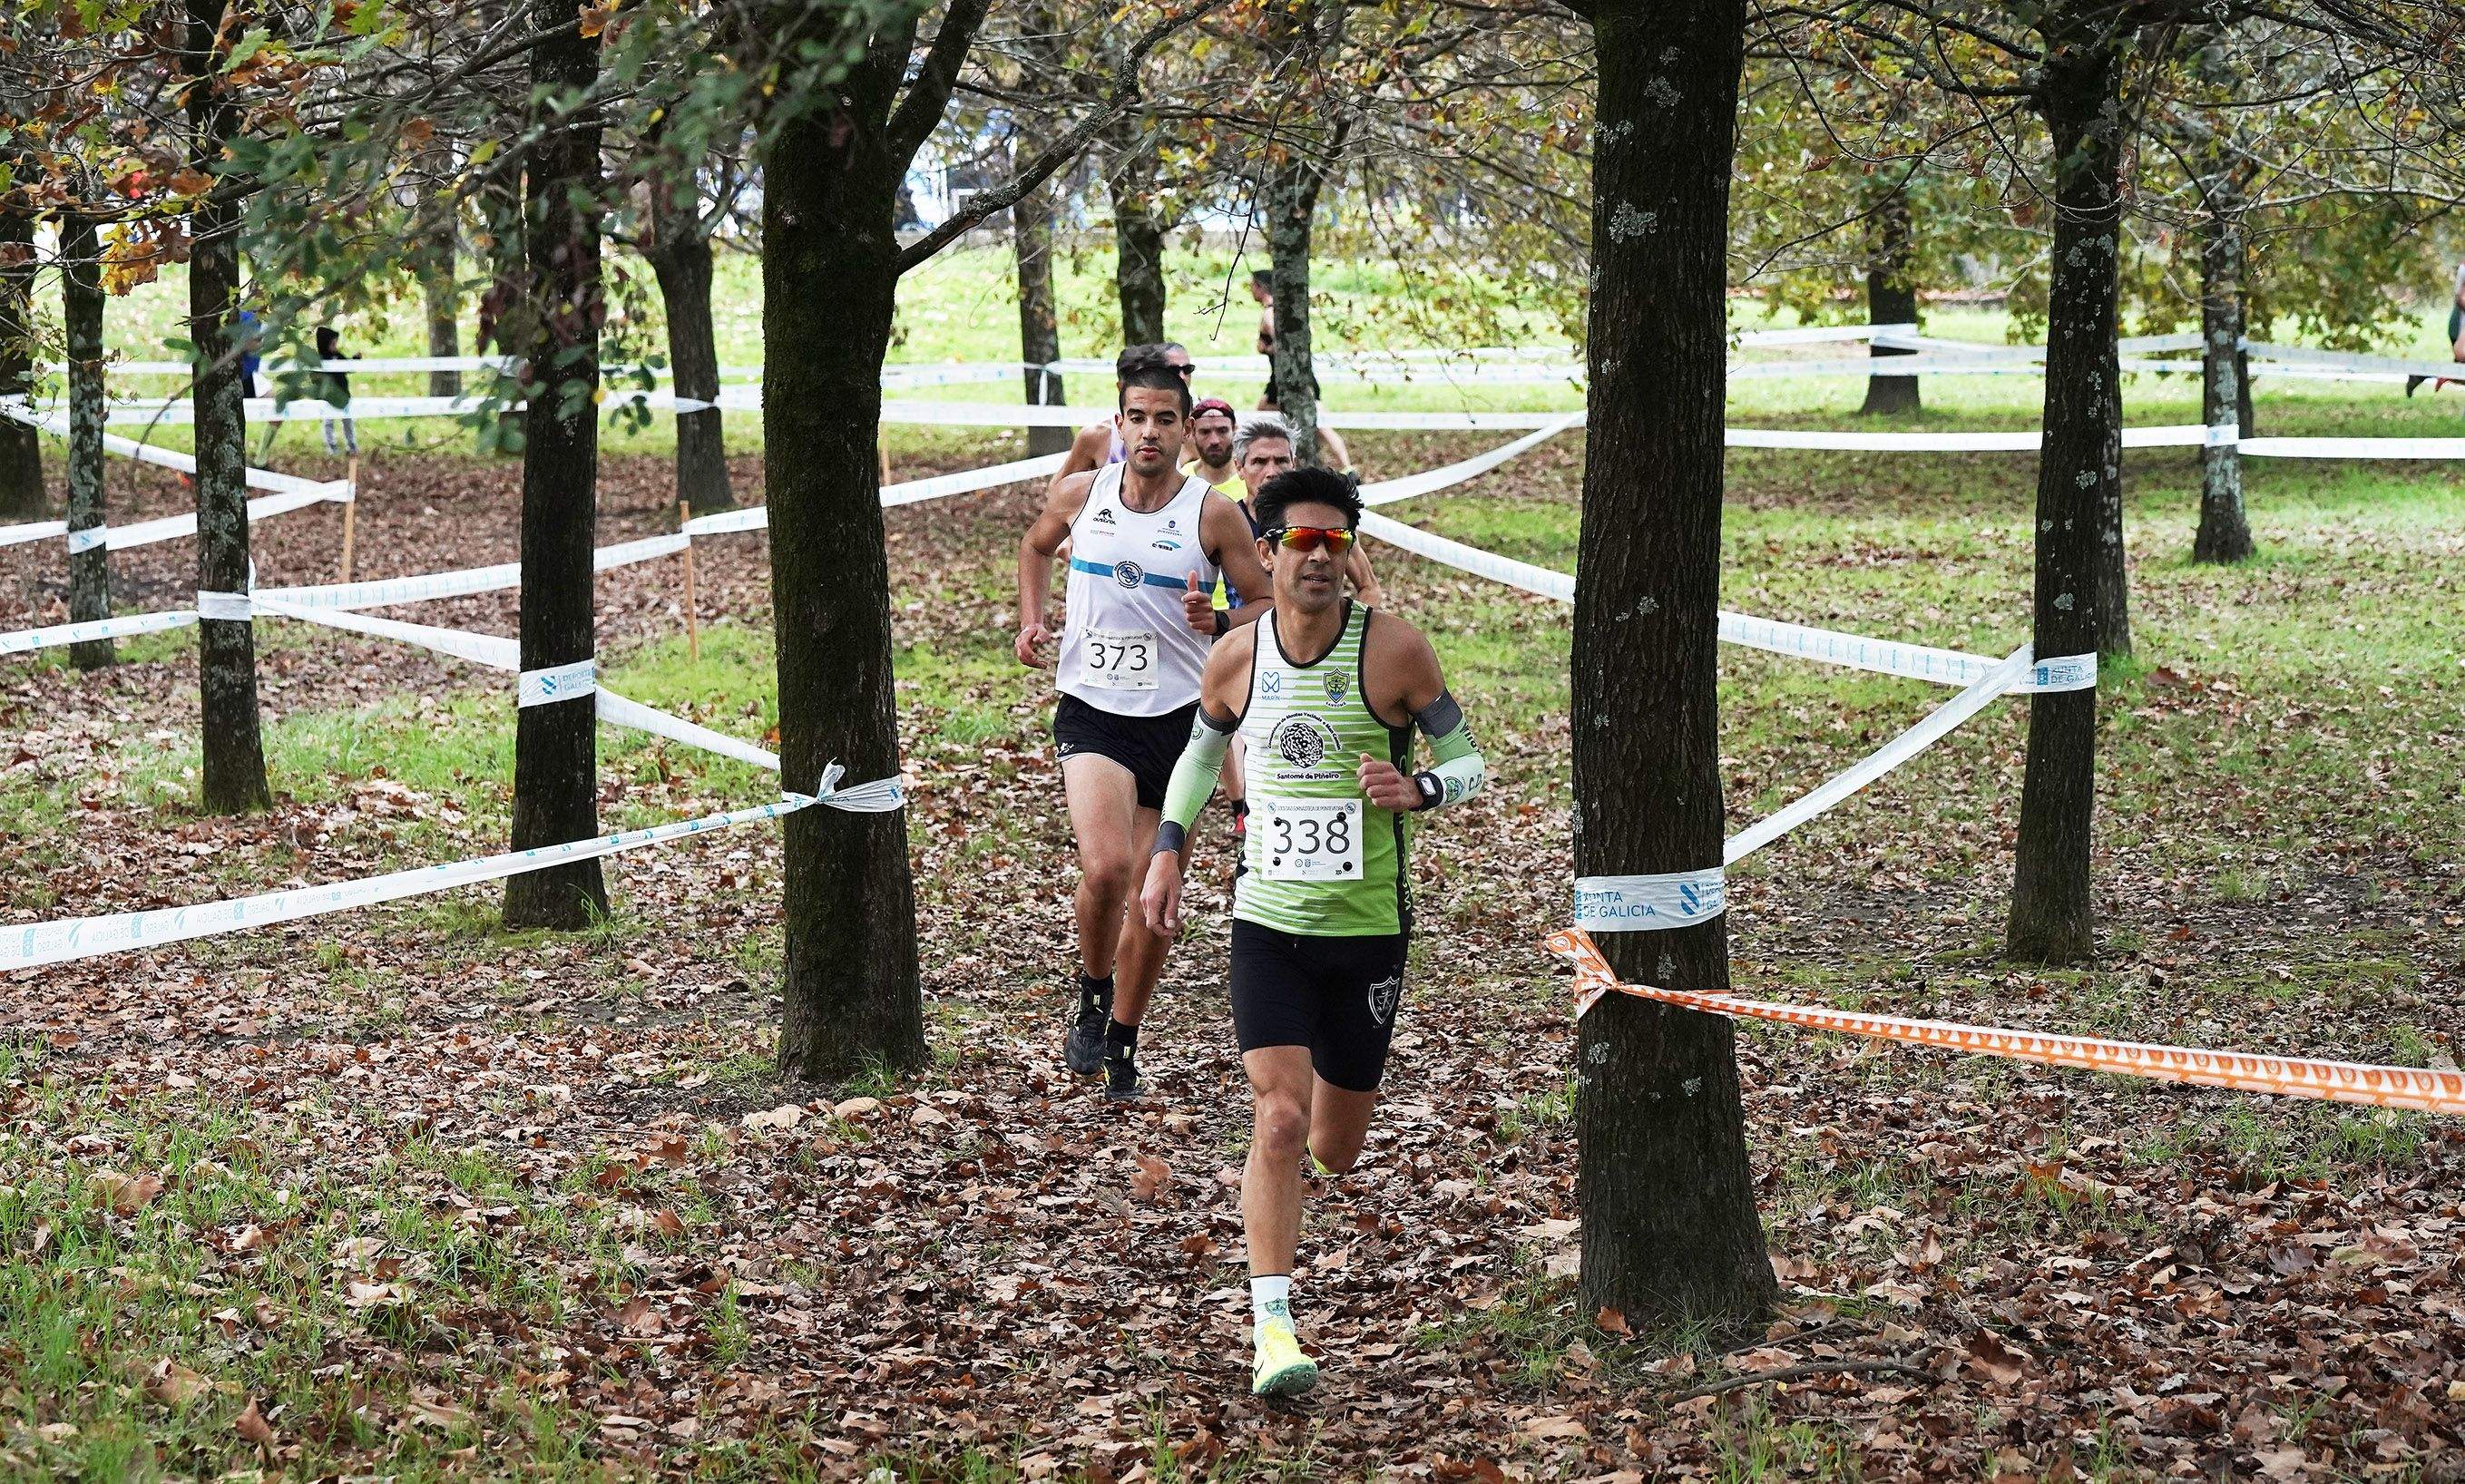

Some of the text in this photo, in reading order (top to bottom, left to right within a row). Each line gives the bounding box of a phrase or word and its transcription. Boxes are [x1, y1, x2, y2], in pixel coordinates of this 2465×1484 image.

[1090, 642, 1148, 671] 373
[1274, 819, 1350, 854] 338
[1599, 904, 1656, 918] GALICIA
